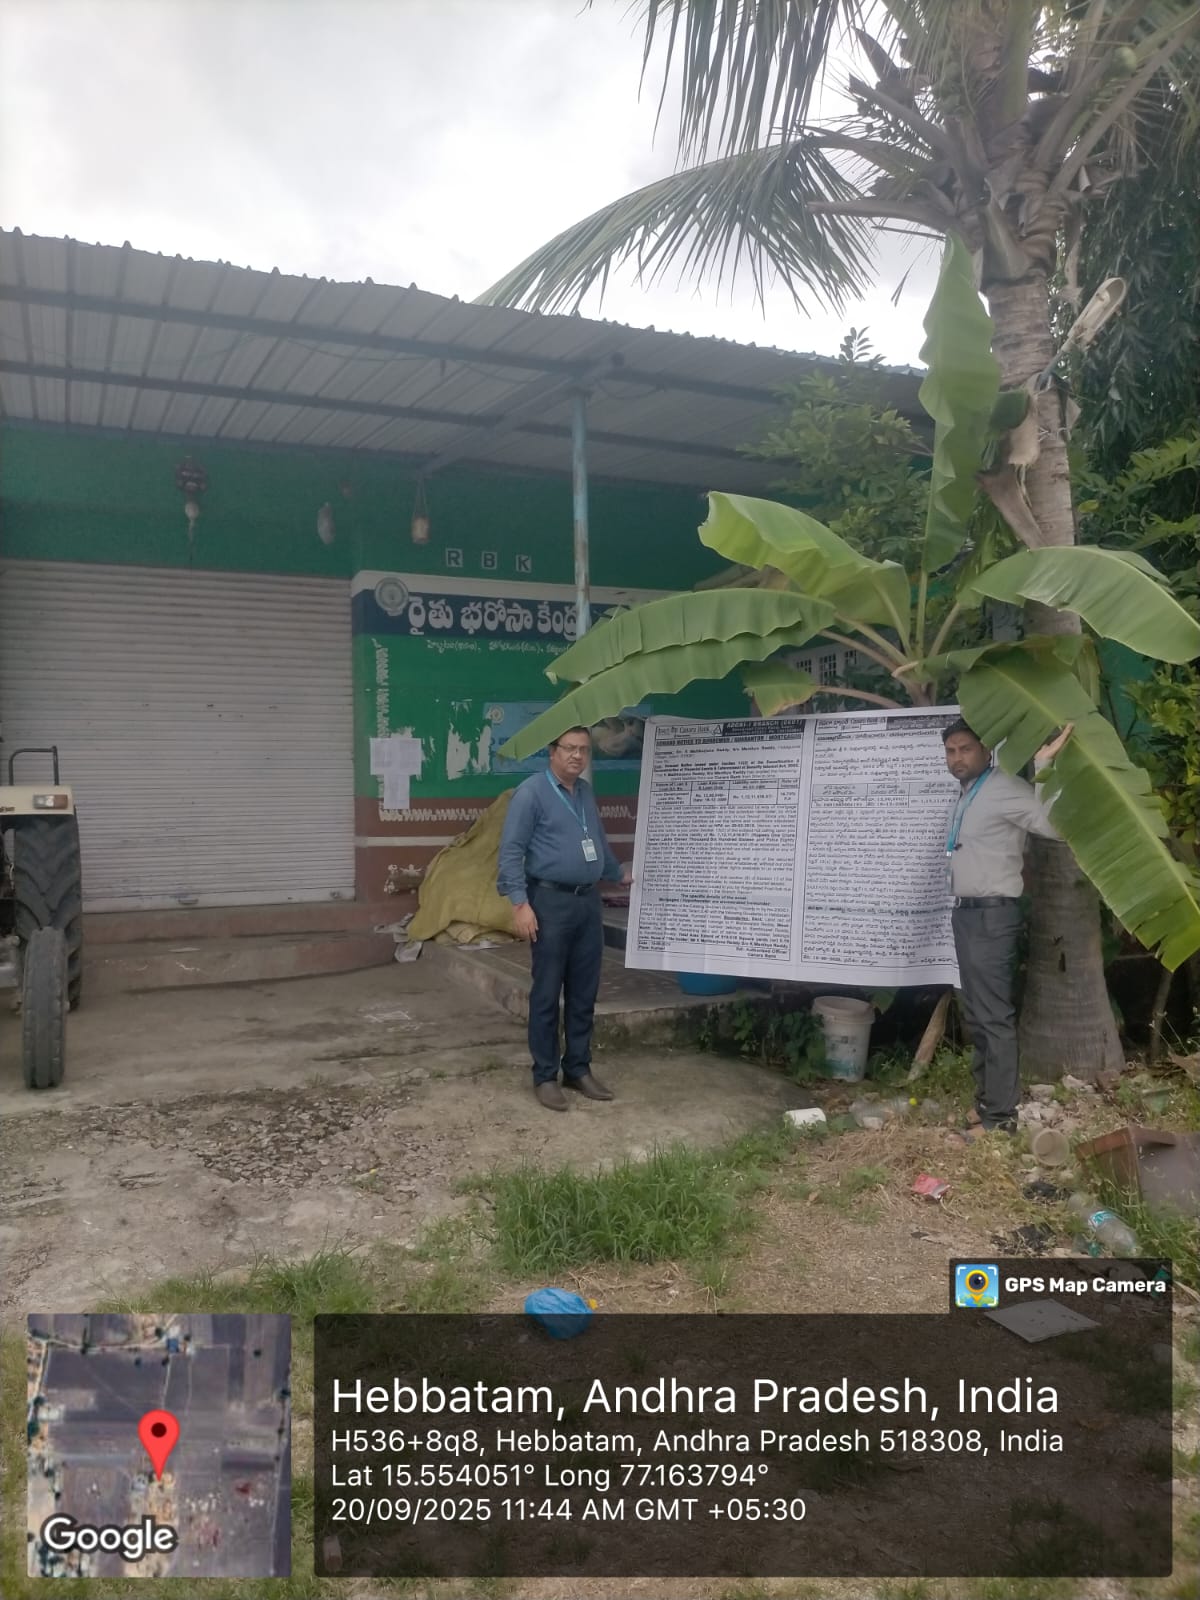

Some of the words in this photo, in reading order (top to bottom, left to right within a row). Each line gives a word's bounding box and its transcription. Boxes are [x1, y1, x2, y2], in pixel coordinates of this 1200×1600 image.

[408, 596, 454, 635] రైతు
[460, 598, 533, 635] భరోసా
[537, 600, 578, 642] కేంద్ర
